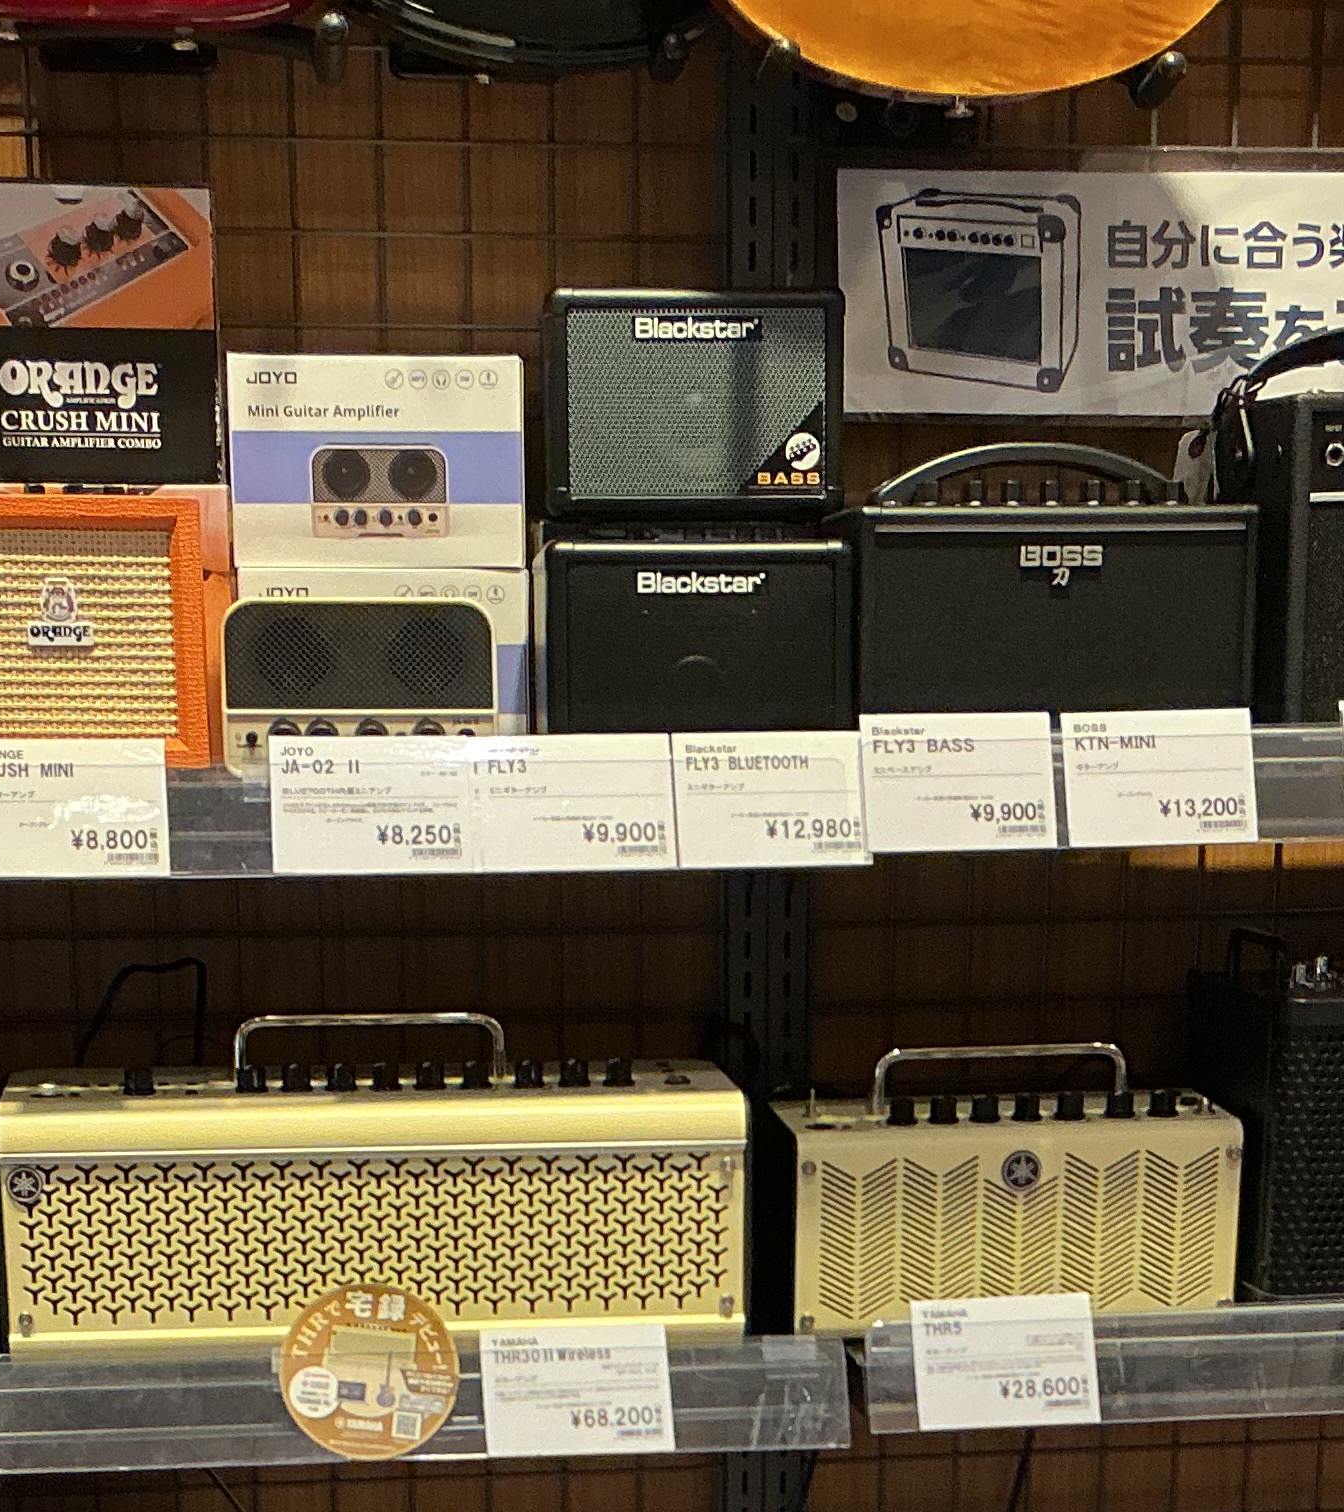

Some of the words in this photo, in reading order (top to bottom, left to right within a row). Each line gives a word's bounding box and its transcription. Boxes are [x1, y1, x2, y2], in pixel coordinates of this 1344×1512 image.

[634, 316, 758, 340] Blackstar
[0, 359, 158, 408] ORANGE
[246, 371, 297, 385] JOYO
[1, 411, 87, 432] CRUSH
[96, 411, 159, 432] MINI
[247, 404, 278, 419] Mini
[283, 404, 329, 419] Guitar
[333, 404, 399, 420] Amplifier
[2, 436, 48, 448] GUITAR
[51, 437, 115, 449] AMPLIFIER
[118, 437, 161, 449] COMBO
[756, 471, 821, 484] BASS
[1020, 545, 1102, 567] BOSS
[637, 572, 765, 594] Blackstar
[30, 624, 90, 642] ORANGE
[1074, 724, 1107, 733] BOSS
[279, 747, 313, 757] JOYO
[873, 740, 915, 754] FLY3
[927, 739, 975, 752] BASS
[1075, 736, 1156, 751] KTN-MINI
[40, 763, 74, 778] MINI
[280, 759, 335, 775] JA-02
[487, 759, 527, 774] FLY3
[685, 755, 720, 771] FLY3
[728, 755, 808, 771] BLUETOOTH
[970, 803, 1036, 823] ¥9,900
[1159, 798, 1237, 819] ¥13,200
[376, 825, 452, 846] ¥8,250
[583, 822, 656, 843] ¥9,900
[766, 818, 852, 839] ¥12,980
[71, 830, 148, 851] ¥8,800
[345, 1291, 406, 1321] 宅録
[924, 1322, 961, 1336] THR5
[999, 1377, 1079, 1398] ¥28,600
[571, 1407, 653, 1428] ¥68,200
